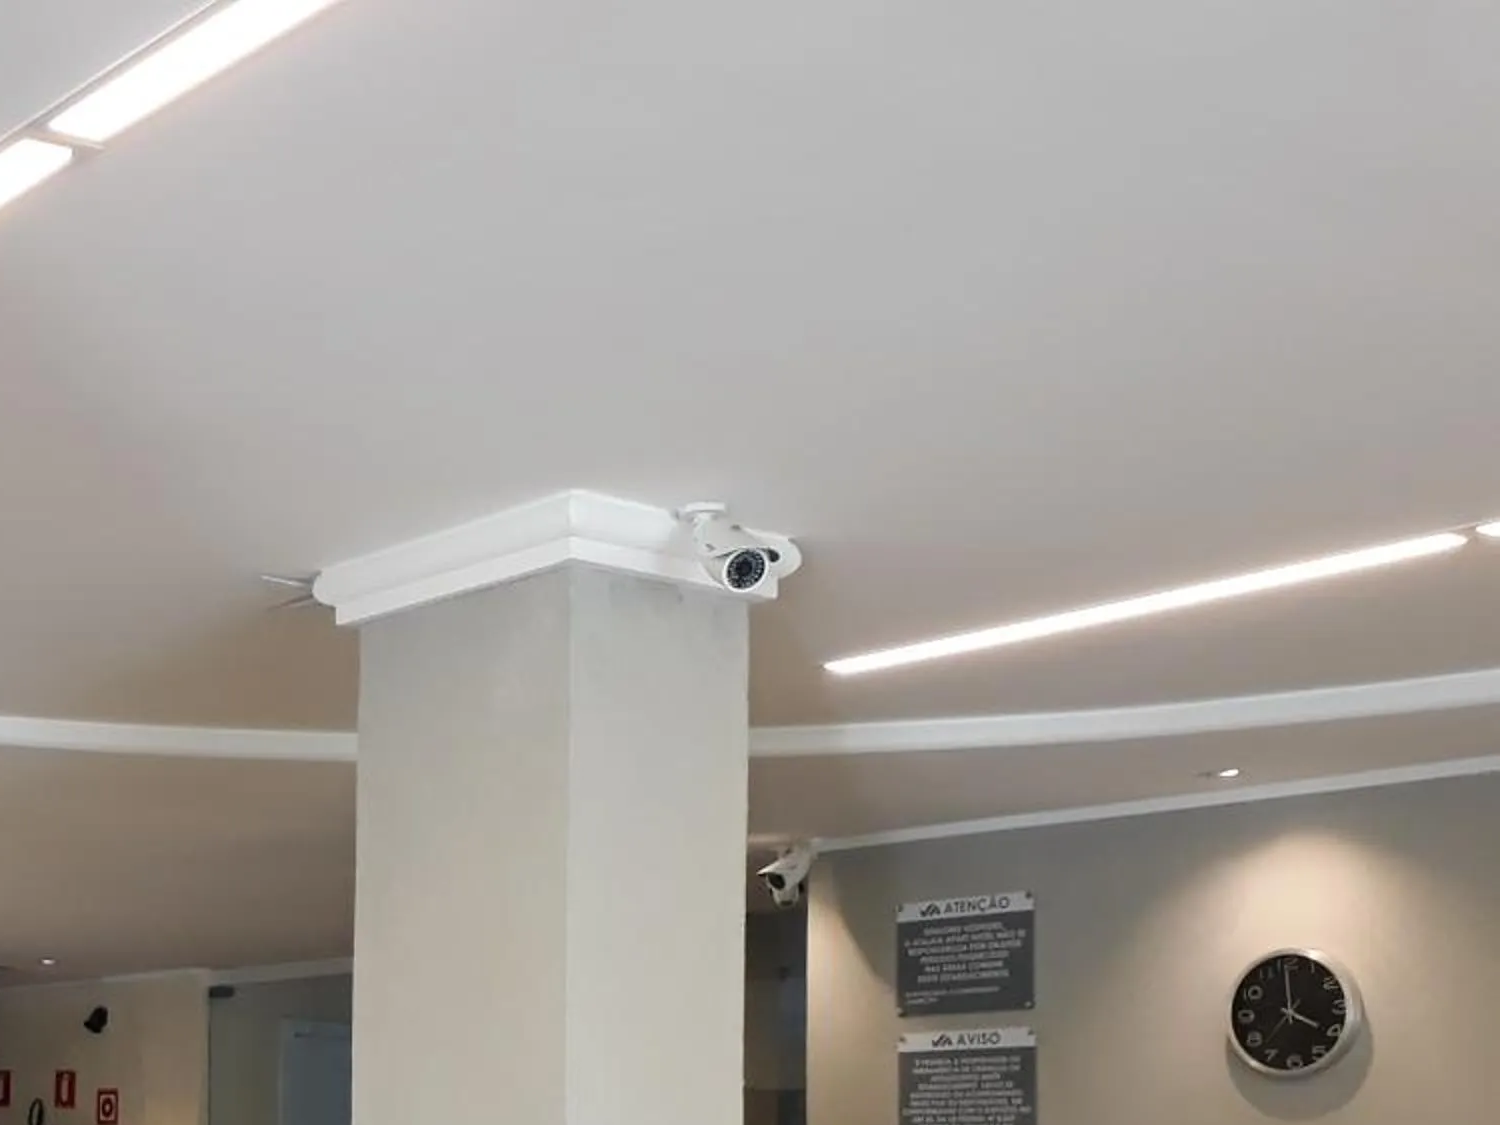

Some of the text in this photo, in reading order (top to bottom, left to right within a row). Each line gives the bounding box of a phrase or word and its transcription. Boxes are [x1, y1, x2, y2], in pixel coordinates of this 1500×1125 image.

[944, 894, 1010, 913] ATENÇÃO
[1243, 984, 1263, 1000] 10
[957, 1031, 1002, 1046] AVISO
[1264, 1049, 1278, 1061] 7
